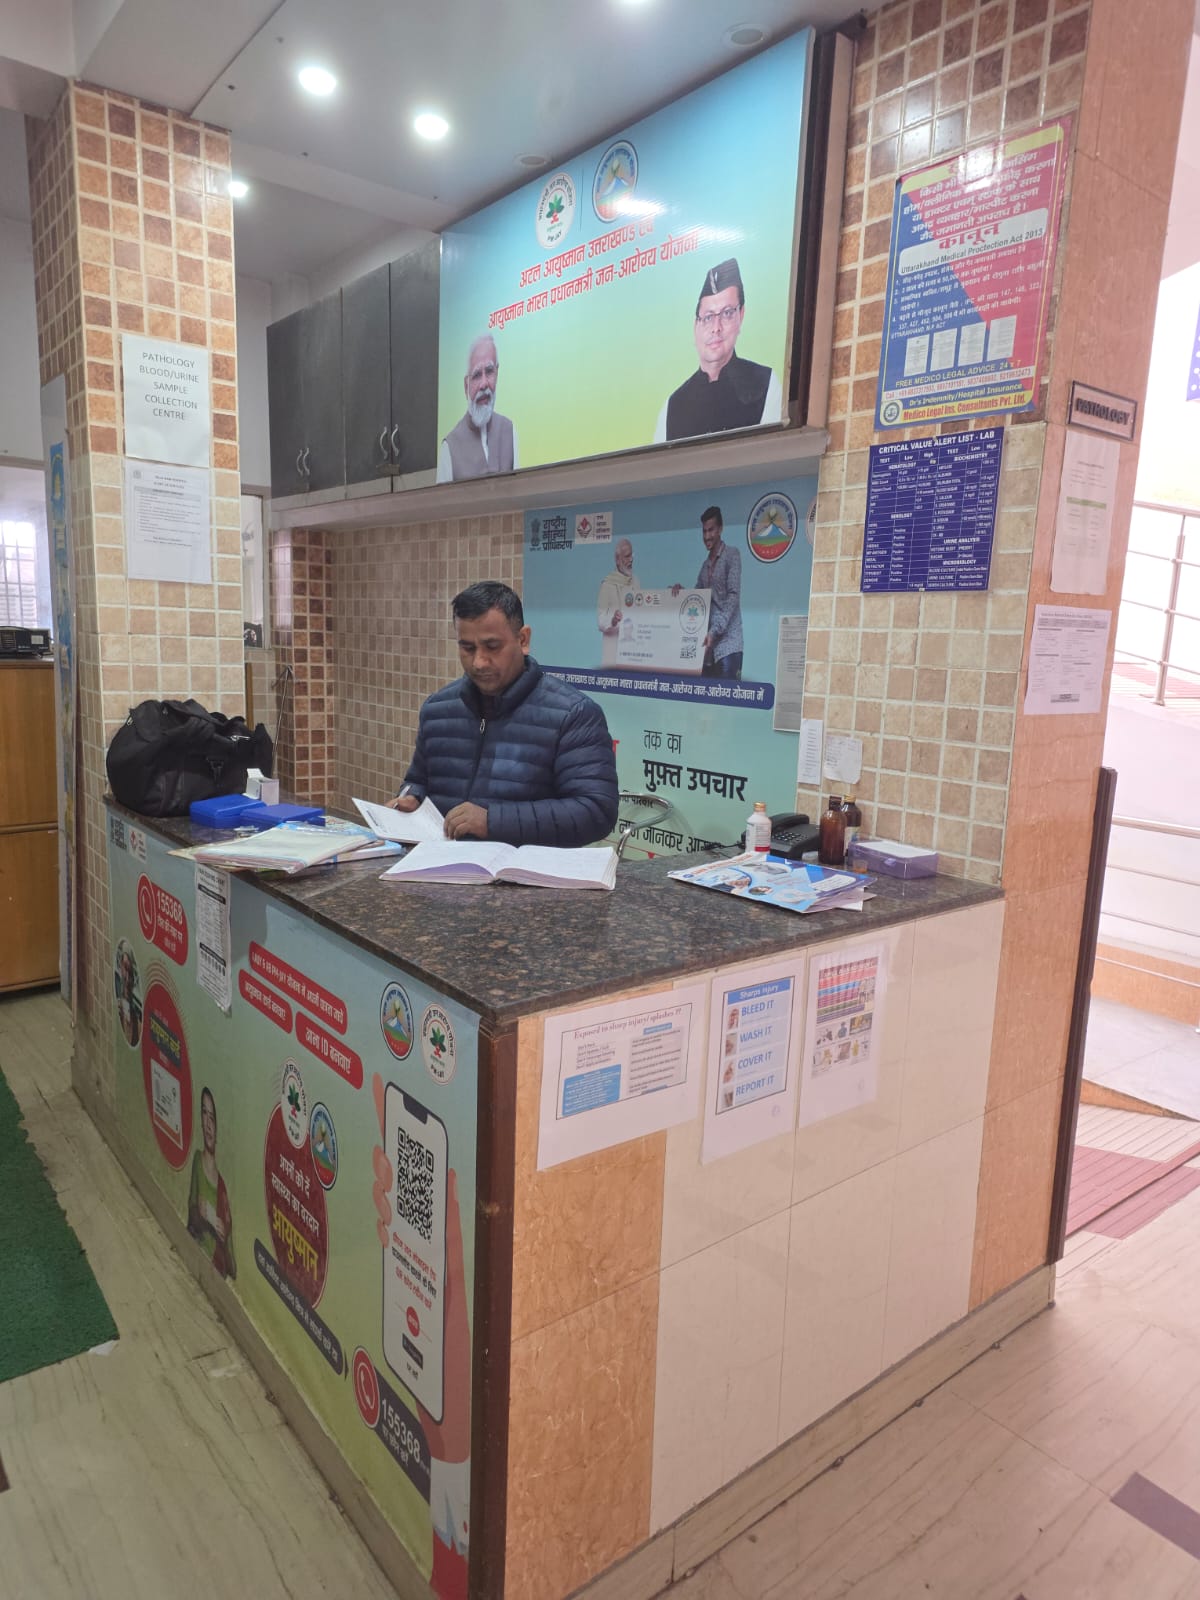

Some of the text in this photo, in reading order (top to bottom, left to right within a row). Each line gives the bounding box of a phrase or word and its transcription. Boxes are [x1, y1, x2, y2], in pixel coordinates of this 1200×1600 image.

[939, 222, 1001, 249] कानून
[520, 263, 541, 288] अटल
[543, 244, 585, 278] आयुष्मान
[588, 225, 636, 258] उत्तराखण्ड
[902, 257, 940, 273] Uttarakhand
[941, 247, 967, 264] Medical
[1010, 234, 1023, 244] Act
[488, 231, 699, 330] आयुष्मान भारत प्रधानमंत्री जन-आरोग्य योजना
[142, 351, 195, 369] PATHOLOGY
[943, 369, 966, 380] LEGAL
[968, 362, 996, 374] ADVICE
[139, 364, 199, 383] BLOOD/URINE
[153, 381, 188, 394] SAMPLE
[145, 394, 198, 410] COLLECTION
[1075, 397, 1131, 425] PATHOLOGY
[152, 408, 185, 421] CENTRE
[879, 443, 909, 454] CRITICAL
[911, 439, 933, 450] VALUE
[934, 436, 957, 447] ALERT
[958, 433, 974, 443] LIST
[980, 431, 995, 440] LAB
[644, 730, 682, 754] तक का
[686, 767, 748, 801] उपचार
[643, 826, 684, 852] जानकर
[157, 890, 183, 925] 155368
[740, 988, 760, 1000] Sharps
[741, 1000, 774, 1017] BLEED IT
[740, 1026, 772, 1042] WASH IT
[738, 1051, 772, 1069] COVER IT
[735, 1075, 774, 1096] REPORT IT
[272, 1203, 319, 1281] आयुष्मान
[381, 1398, 421, 1464] 155368
